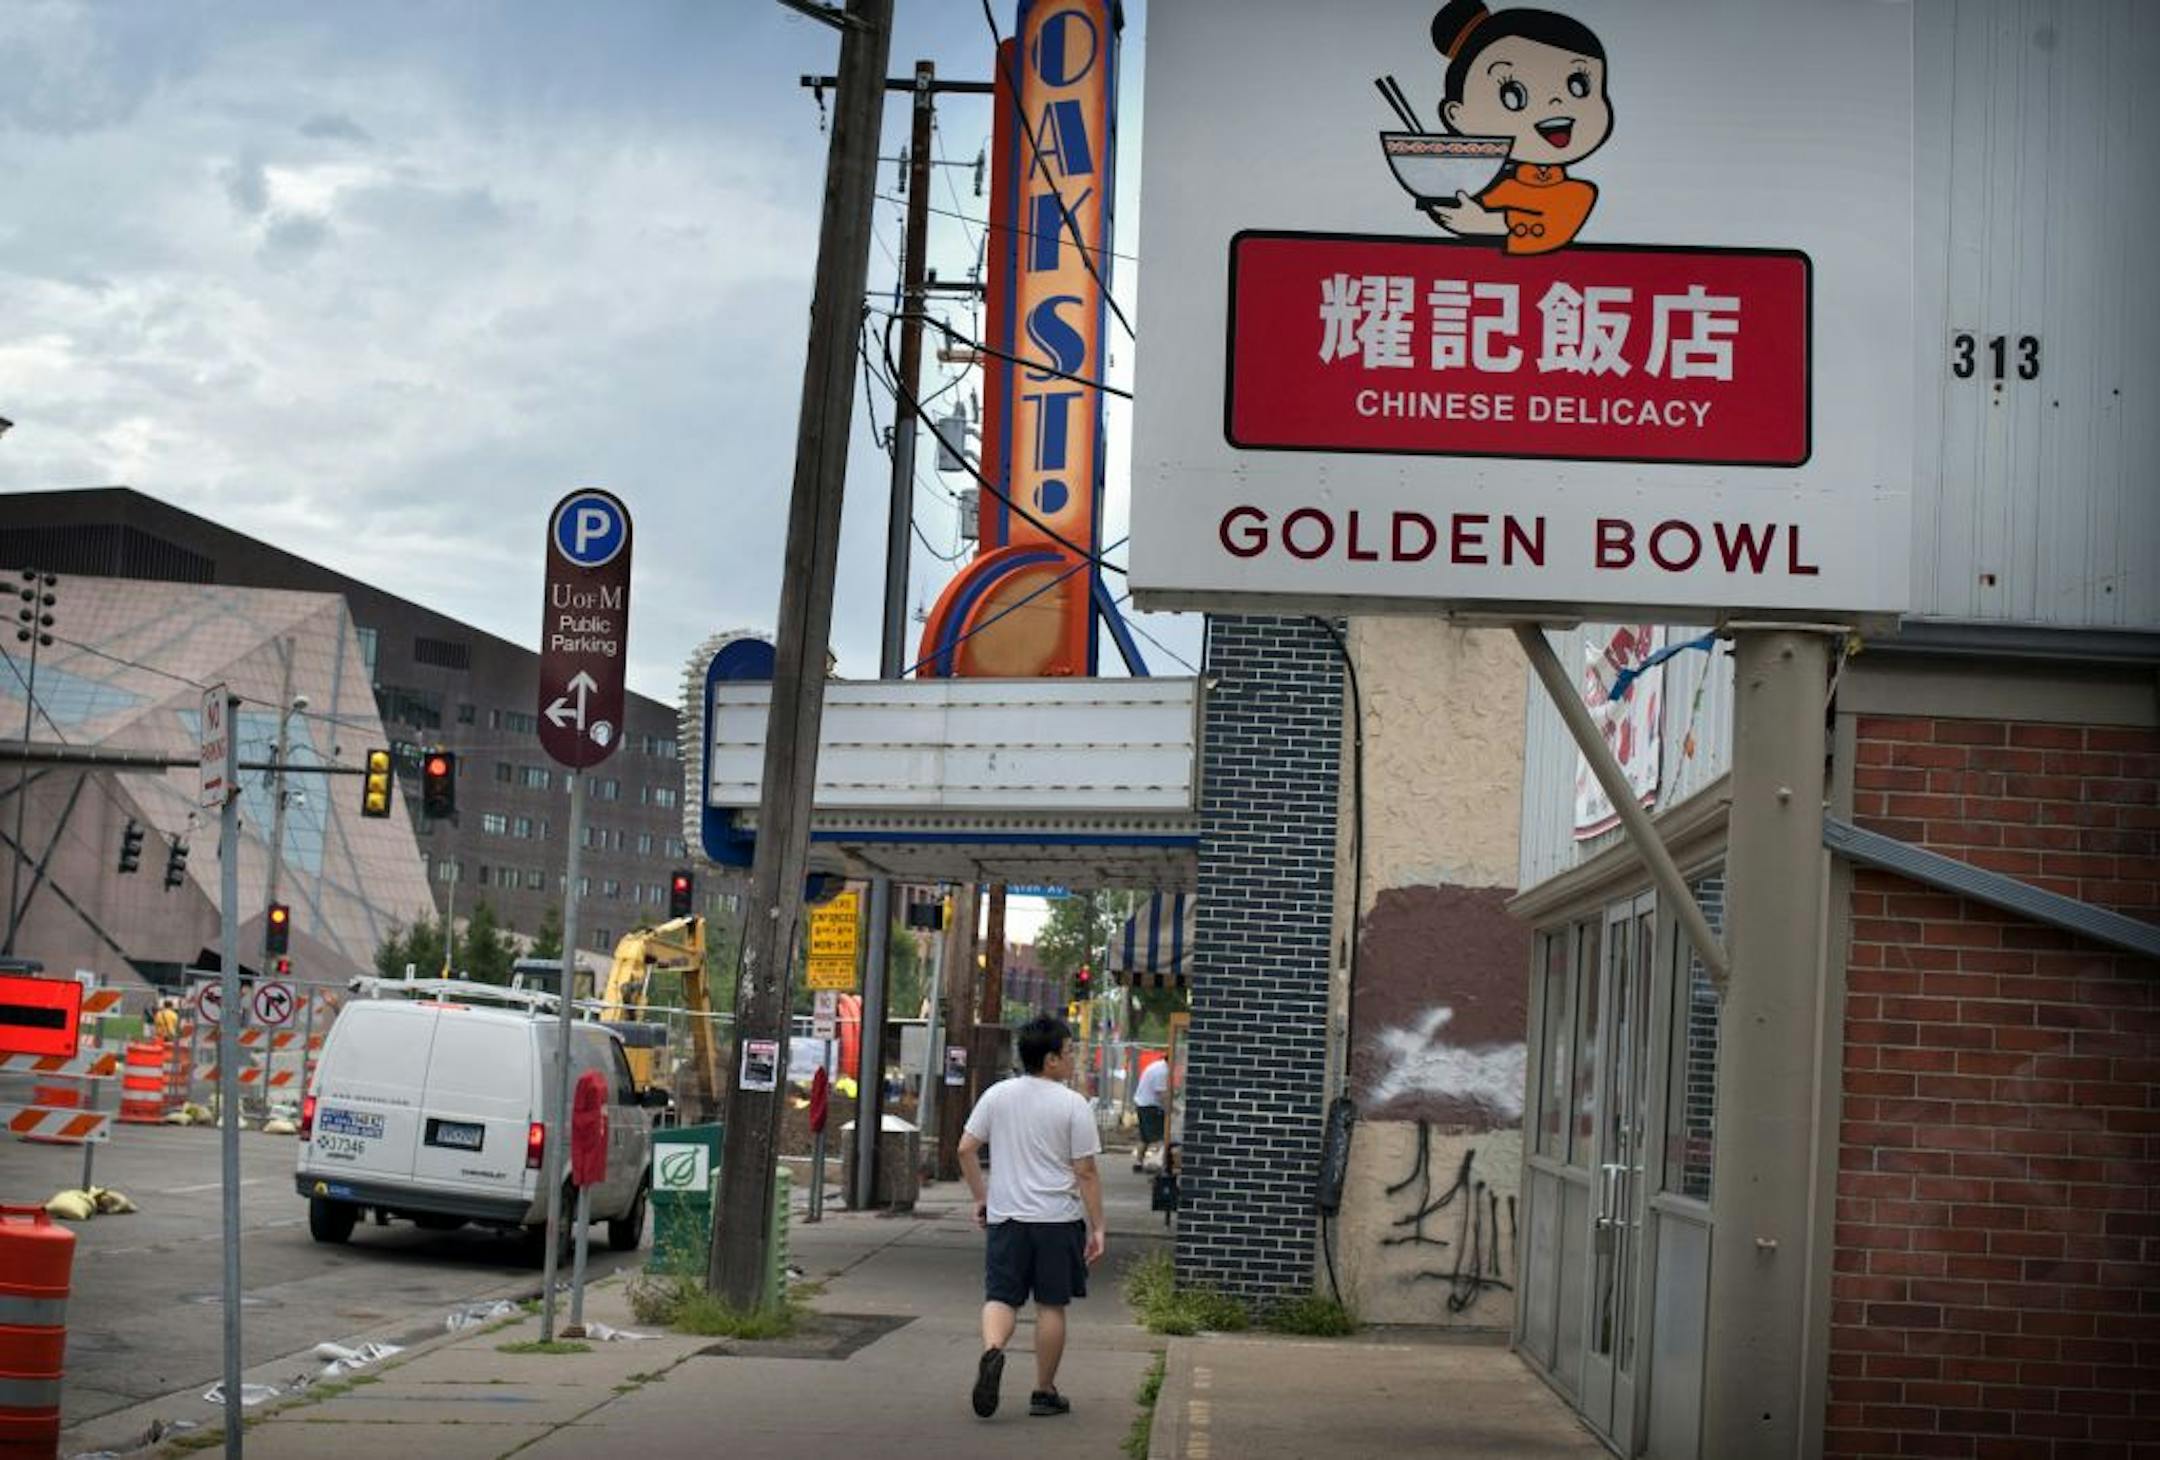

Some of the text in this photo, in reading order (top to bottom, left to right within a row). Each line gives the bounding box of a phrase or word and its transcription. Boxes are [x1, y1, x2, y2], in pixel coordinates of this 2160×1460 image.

[1030, 9, 1096, 273] OAK
[1319, 273, 1741, 381] 耀記飯店
[1953, 334, 2040, 380] 313
[1356, 389, 1712, 428] CHINESE DELICACY
[575, 508, 611, 554] P
[1219, 506, 1820, 576] GOLDEN BOWL
[551, 634, 617, 657] Parking
[560, 615, 611, 634] Public
